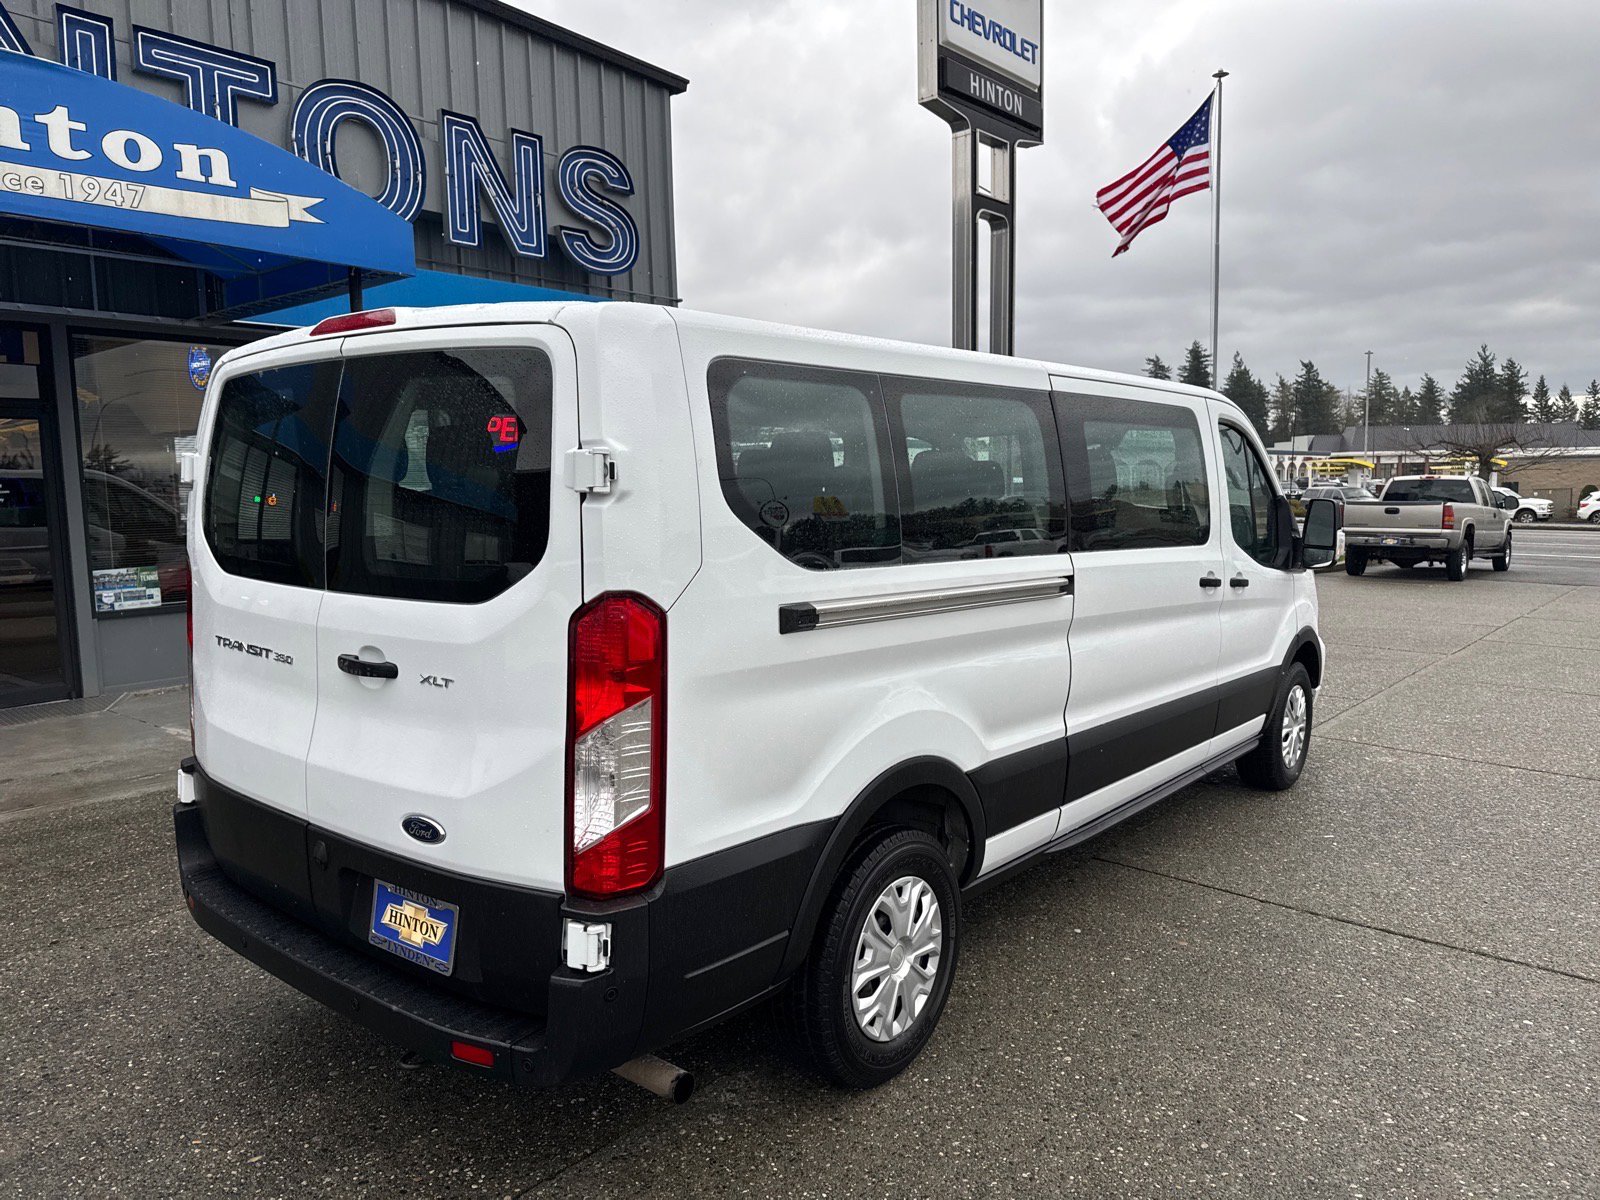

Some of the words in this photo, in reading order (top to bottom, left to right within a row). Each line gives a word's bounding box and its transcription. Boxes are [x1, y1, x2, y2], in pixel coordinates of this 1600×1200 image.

[950, 0, 1039, 65] CHEVROLET
[970, 72, 1023, 117] HINTON
[58, 173, 146, 209] 1947
[215, 635, 273, 660] TRANSIT
[273, 651, 294, 666] 350
[419, 673, 455, 689] XLT
[408, 820, 433, 840] Ford
[393, 886, 438, 908] HINTON
[388, 908, 440, 941] HINTON
[386, 940, 431, 967] LYNDEN
